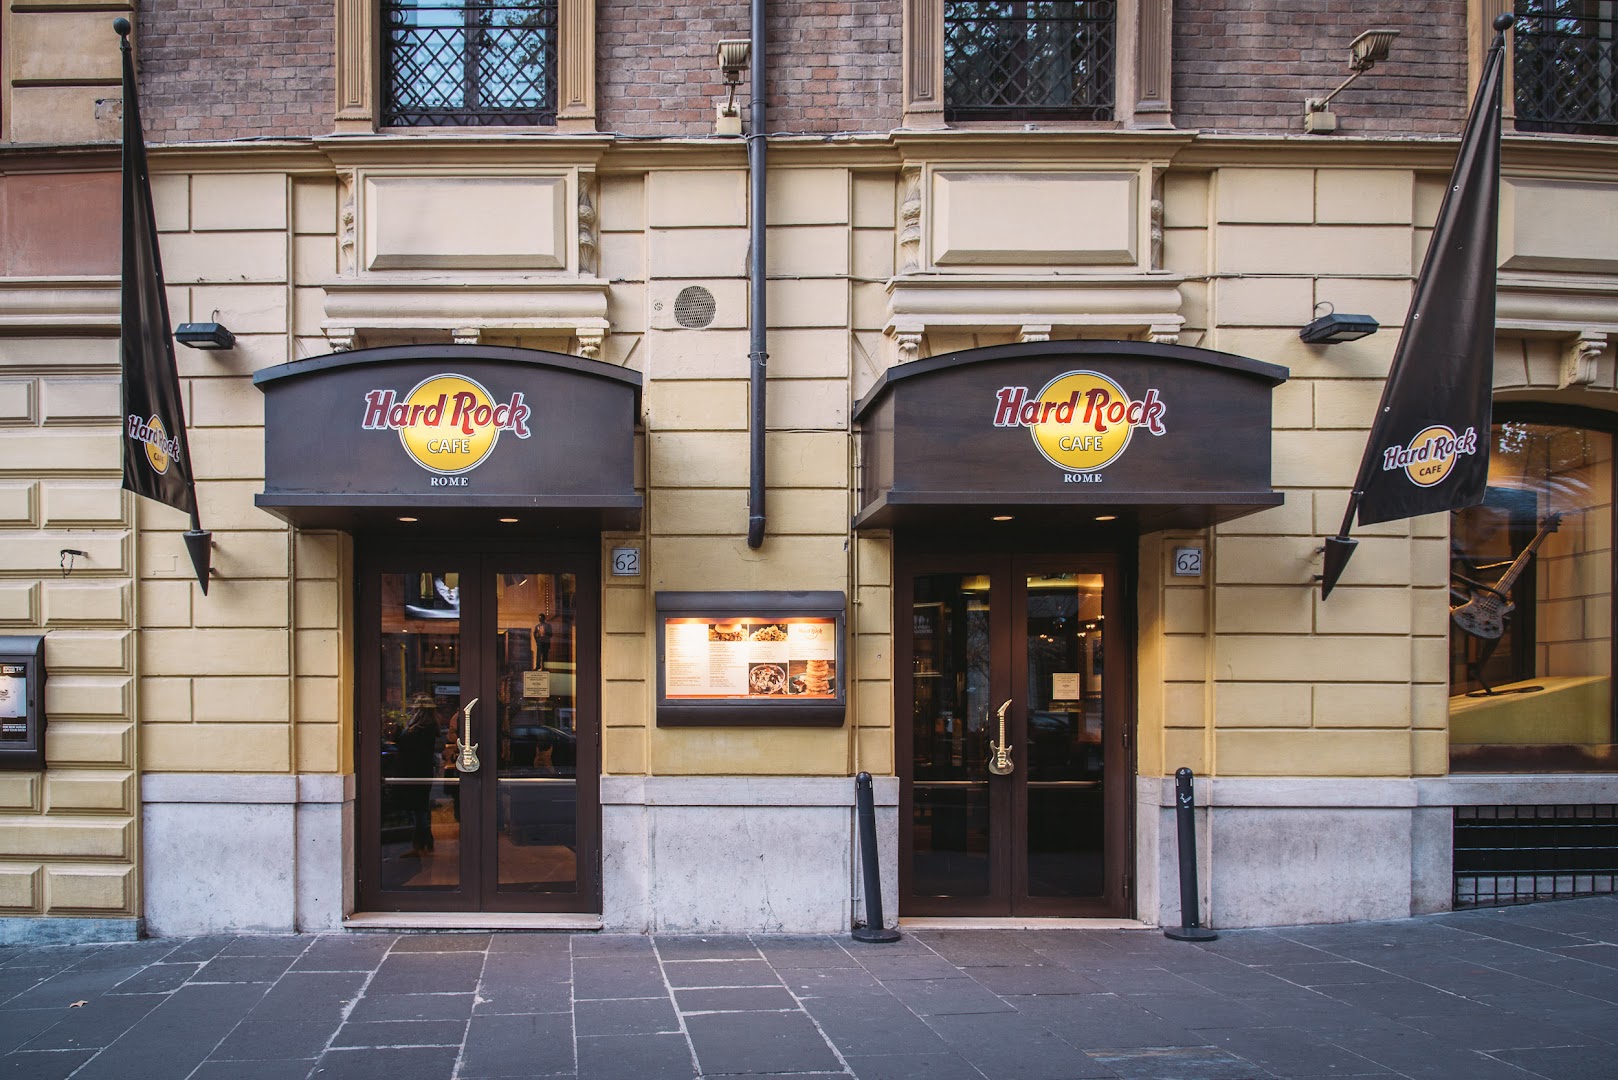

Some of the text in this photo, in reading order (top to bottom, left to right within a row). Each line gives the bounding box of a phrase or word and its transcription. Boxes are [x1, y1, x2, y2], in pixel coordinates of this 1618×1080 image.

[362, 390, 531, 439] Hard Rock
[993, 387, 1166, 436] Hard Rock
[129, 414, 180, 462] Hard Rock
[427, 439, 470, 454] CAFE
[1059, 435, 1103, 451] CAFE
[1383, 427, 1477, 471] Hard Rock
[1064, 474, 1103, 483] ROME
[1419, 465, 1442, 477] CAFE
[430, 477, 469, 487] ROME
[616, 553, 637, 571] 62
[1178, 553, 1199, 571] 62
